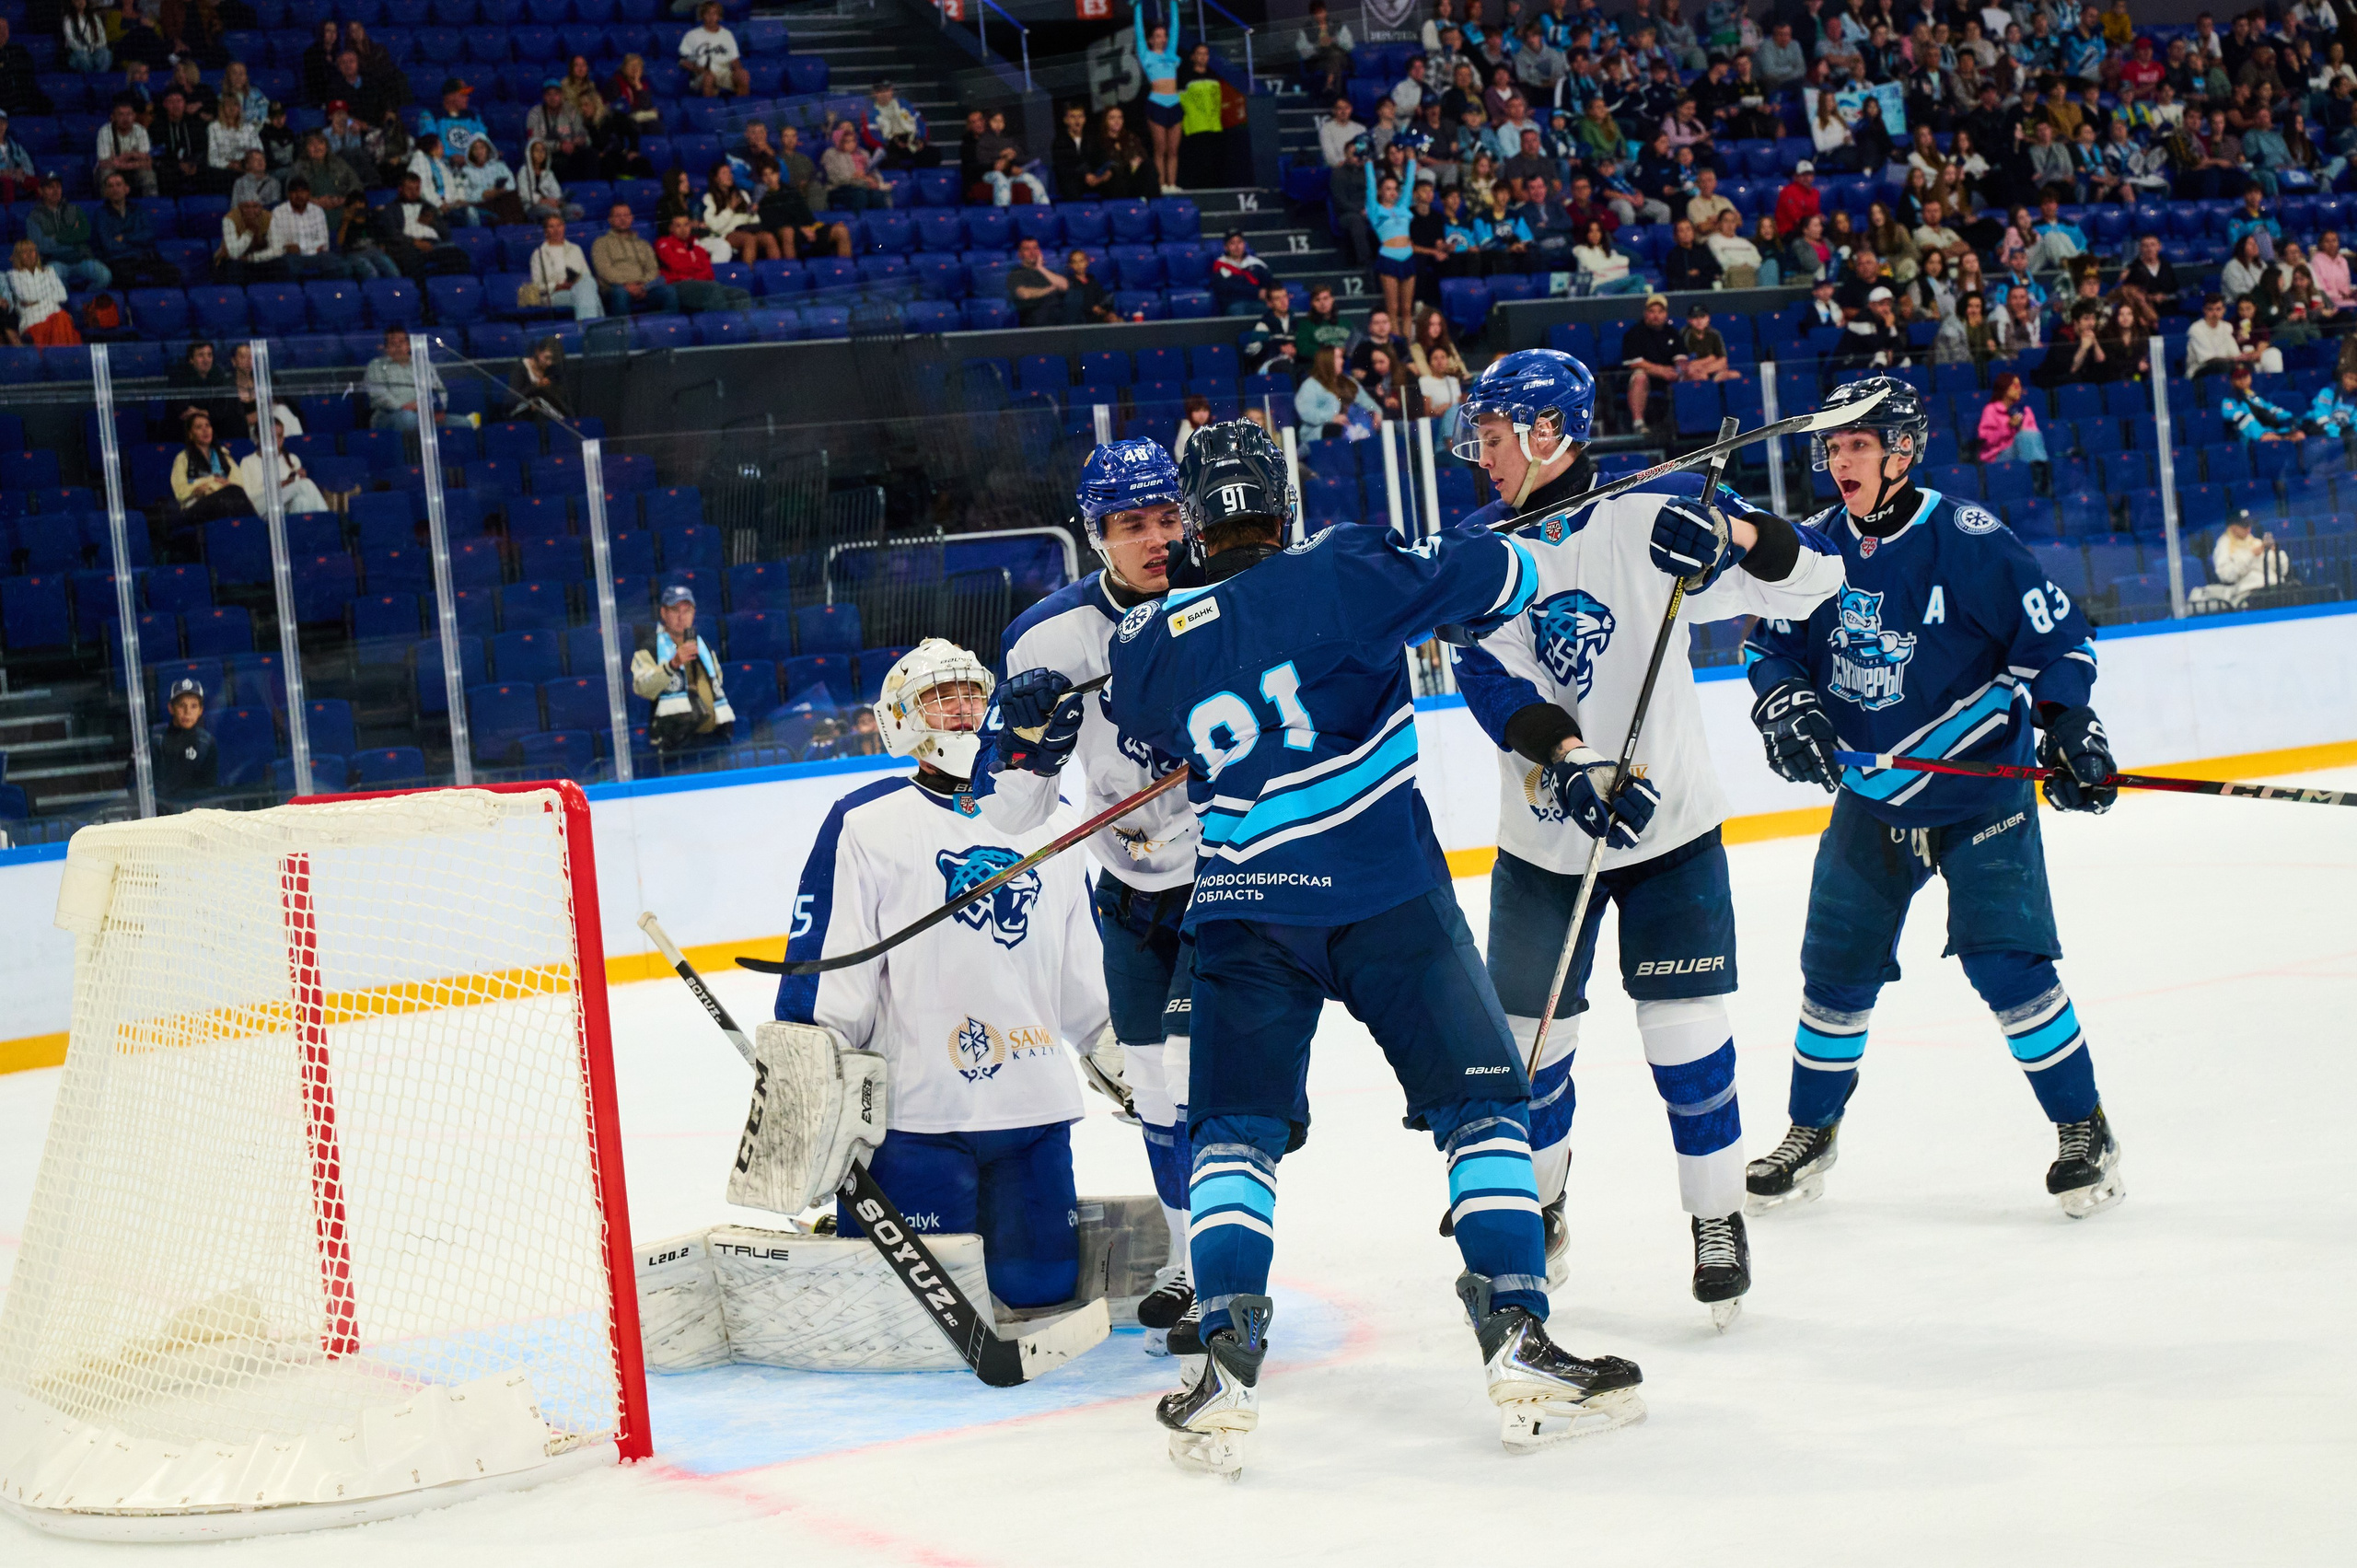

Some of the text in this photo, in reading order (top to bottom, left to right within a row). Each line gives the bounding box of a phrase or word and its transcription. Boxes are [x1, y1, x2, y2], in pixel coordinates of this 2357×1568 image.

[1237, 193, 1259, 212] 14
[1288, 236, 1309, 253] 13
[1343, 278, 1364, 296] 12
[1636, 460, 1677, 481] SOYUZ
[1129, 478, 1164, 491] BAUER
[1221, 487, 1247, 513] 91
[1861, 504, 1894, 523] CM
[1187, 606, 1213, 623] БАНК
[1922, 585, 1945, 625] A
[2022, 580, 2072, 634] 83
[877, 709, 893, 749] BAUER
[2219, 783, 2345, 806] CCM
[1972, 811, 2026, 846] BAUER
[1199, 874, 1333, 889] НОВОСИБИРСКАЯ
[1197, 889, 1264, 903] ОБЛАСТЬ
[1633, 956, 1725, 979] BAUER
[685, 976, 722, 1018] SOYUZ
[1464, 1066, 1511, 1075] BAUER
[736, 1057, 770, 1175] CCM
[900, 1211, 941, 1231] alyk
[648, 1247, 690, 1266] L20.2
[714, 1243, 789, 1261] TRUE
[855, 1198, 958, 1328] SOYUZ BC
[1555, 1361, 1599, 1376] BAUER
